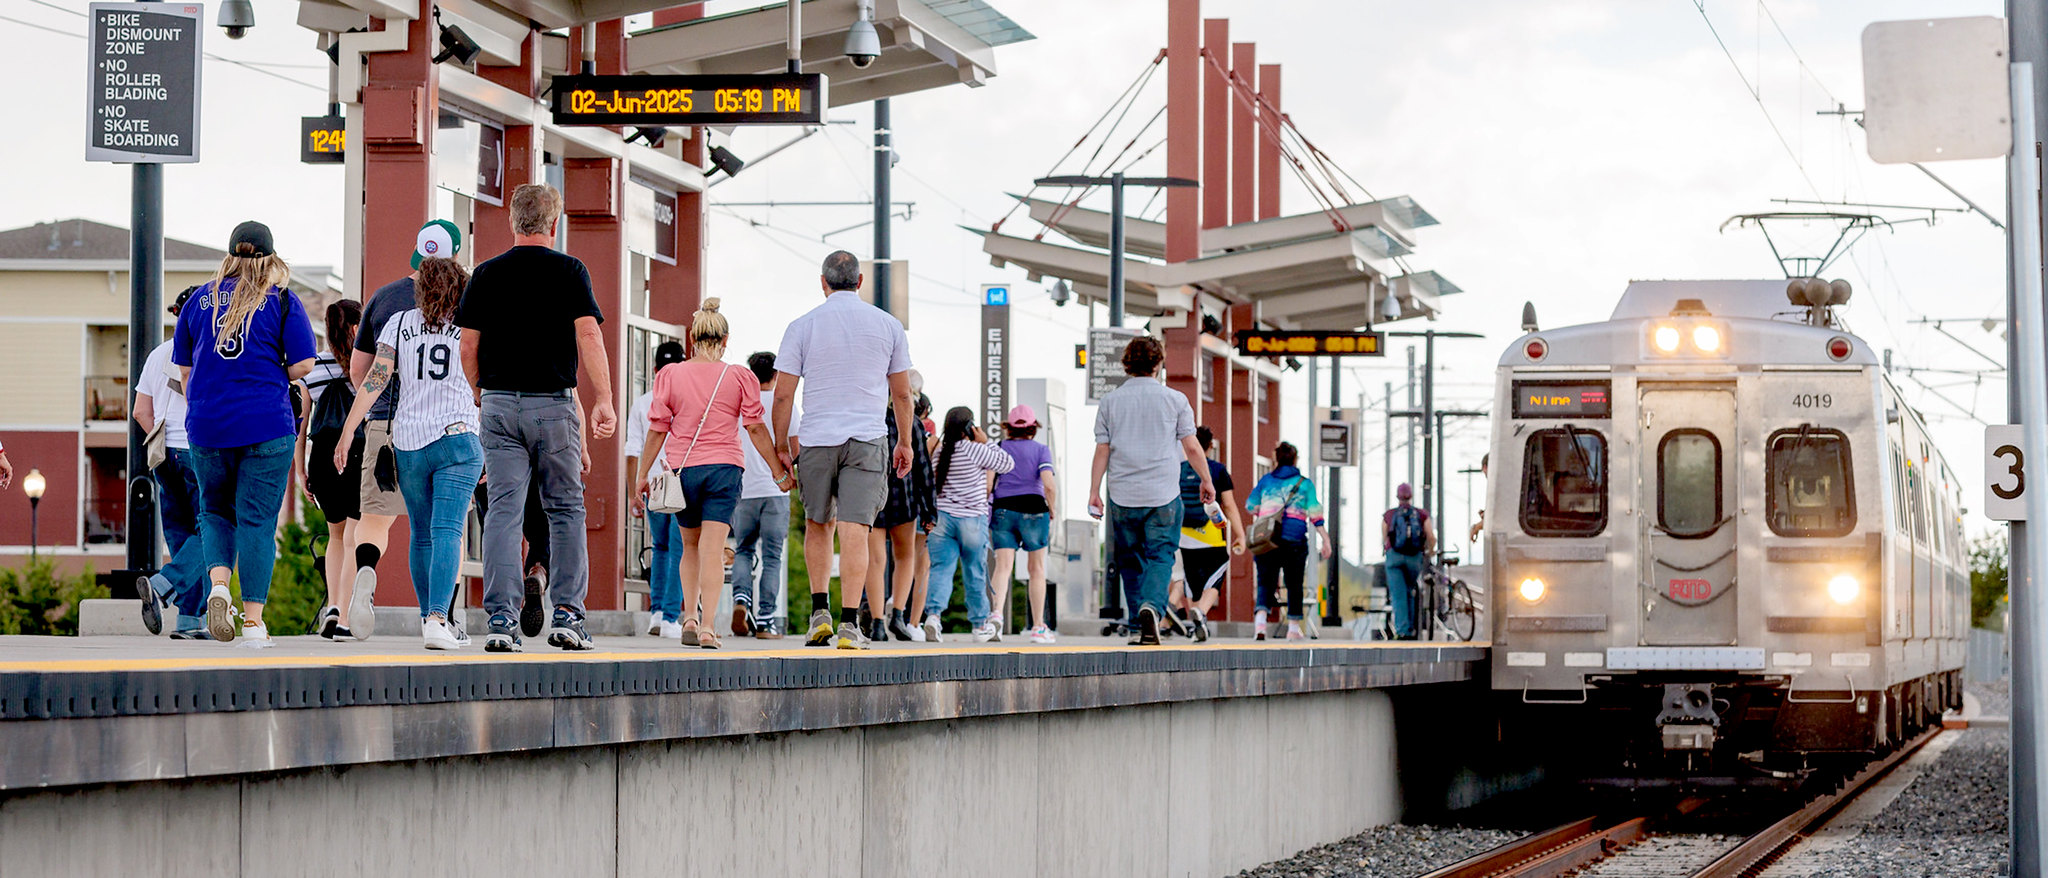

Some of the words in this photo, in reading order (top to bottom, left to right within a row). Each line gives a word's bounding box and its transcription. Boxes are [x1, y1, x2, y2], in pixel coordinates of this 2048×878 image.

[107, 13, 140, 26] BIKE
[106, 28, 182, 41] DISMOUNT
[105, 42, 145, 55] ZONE
[106, 59, 128, 72] NO
[105, 73, 161, 86] ROLLER
[105, 87, 168, 101] BLADING
[570, 89, 693, 114] 02-Jun-2025
[714, 88, 763, 113] 05:19
[772, 88, 801, 113] PM
[105, 105, 126, 118] NO
[104, 119, 150, 132] SKATE
[103, 133, 179, 147] BOARDING
[416, 343, 451, 381] 19
[1792, 393, 1832, 408] 4019
[1990, 444, 2025, 500] 3
[1669, 579, 1711, 600] RTD
